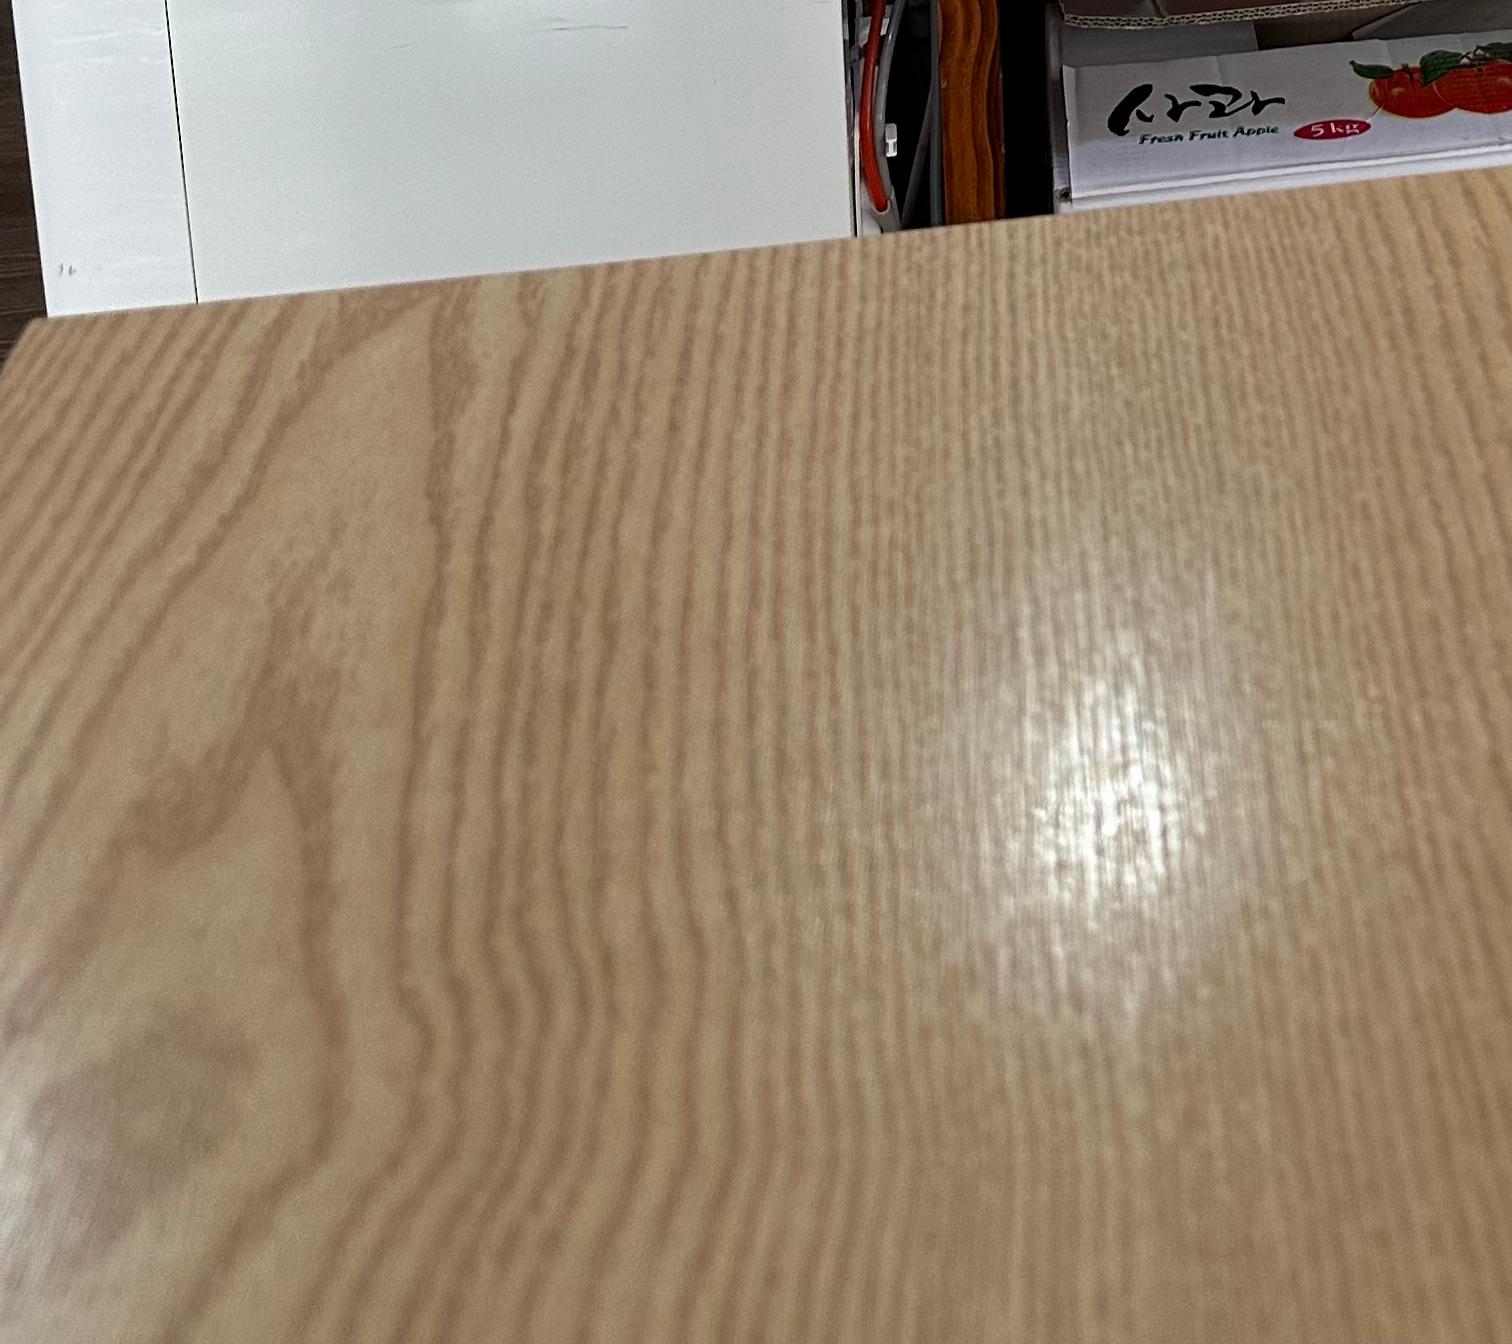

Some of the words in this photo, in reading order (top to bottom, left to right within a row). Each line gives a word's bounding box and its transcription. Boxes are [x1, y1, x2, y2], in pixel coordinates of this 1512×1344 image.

[1138, 132, 1185, 145] Fresh
[1188, 129, 1230, 142] Fruit
[1232, 124, 1281, 138] Apple
